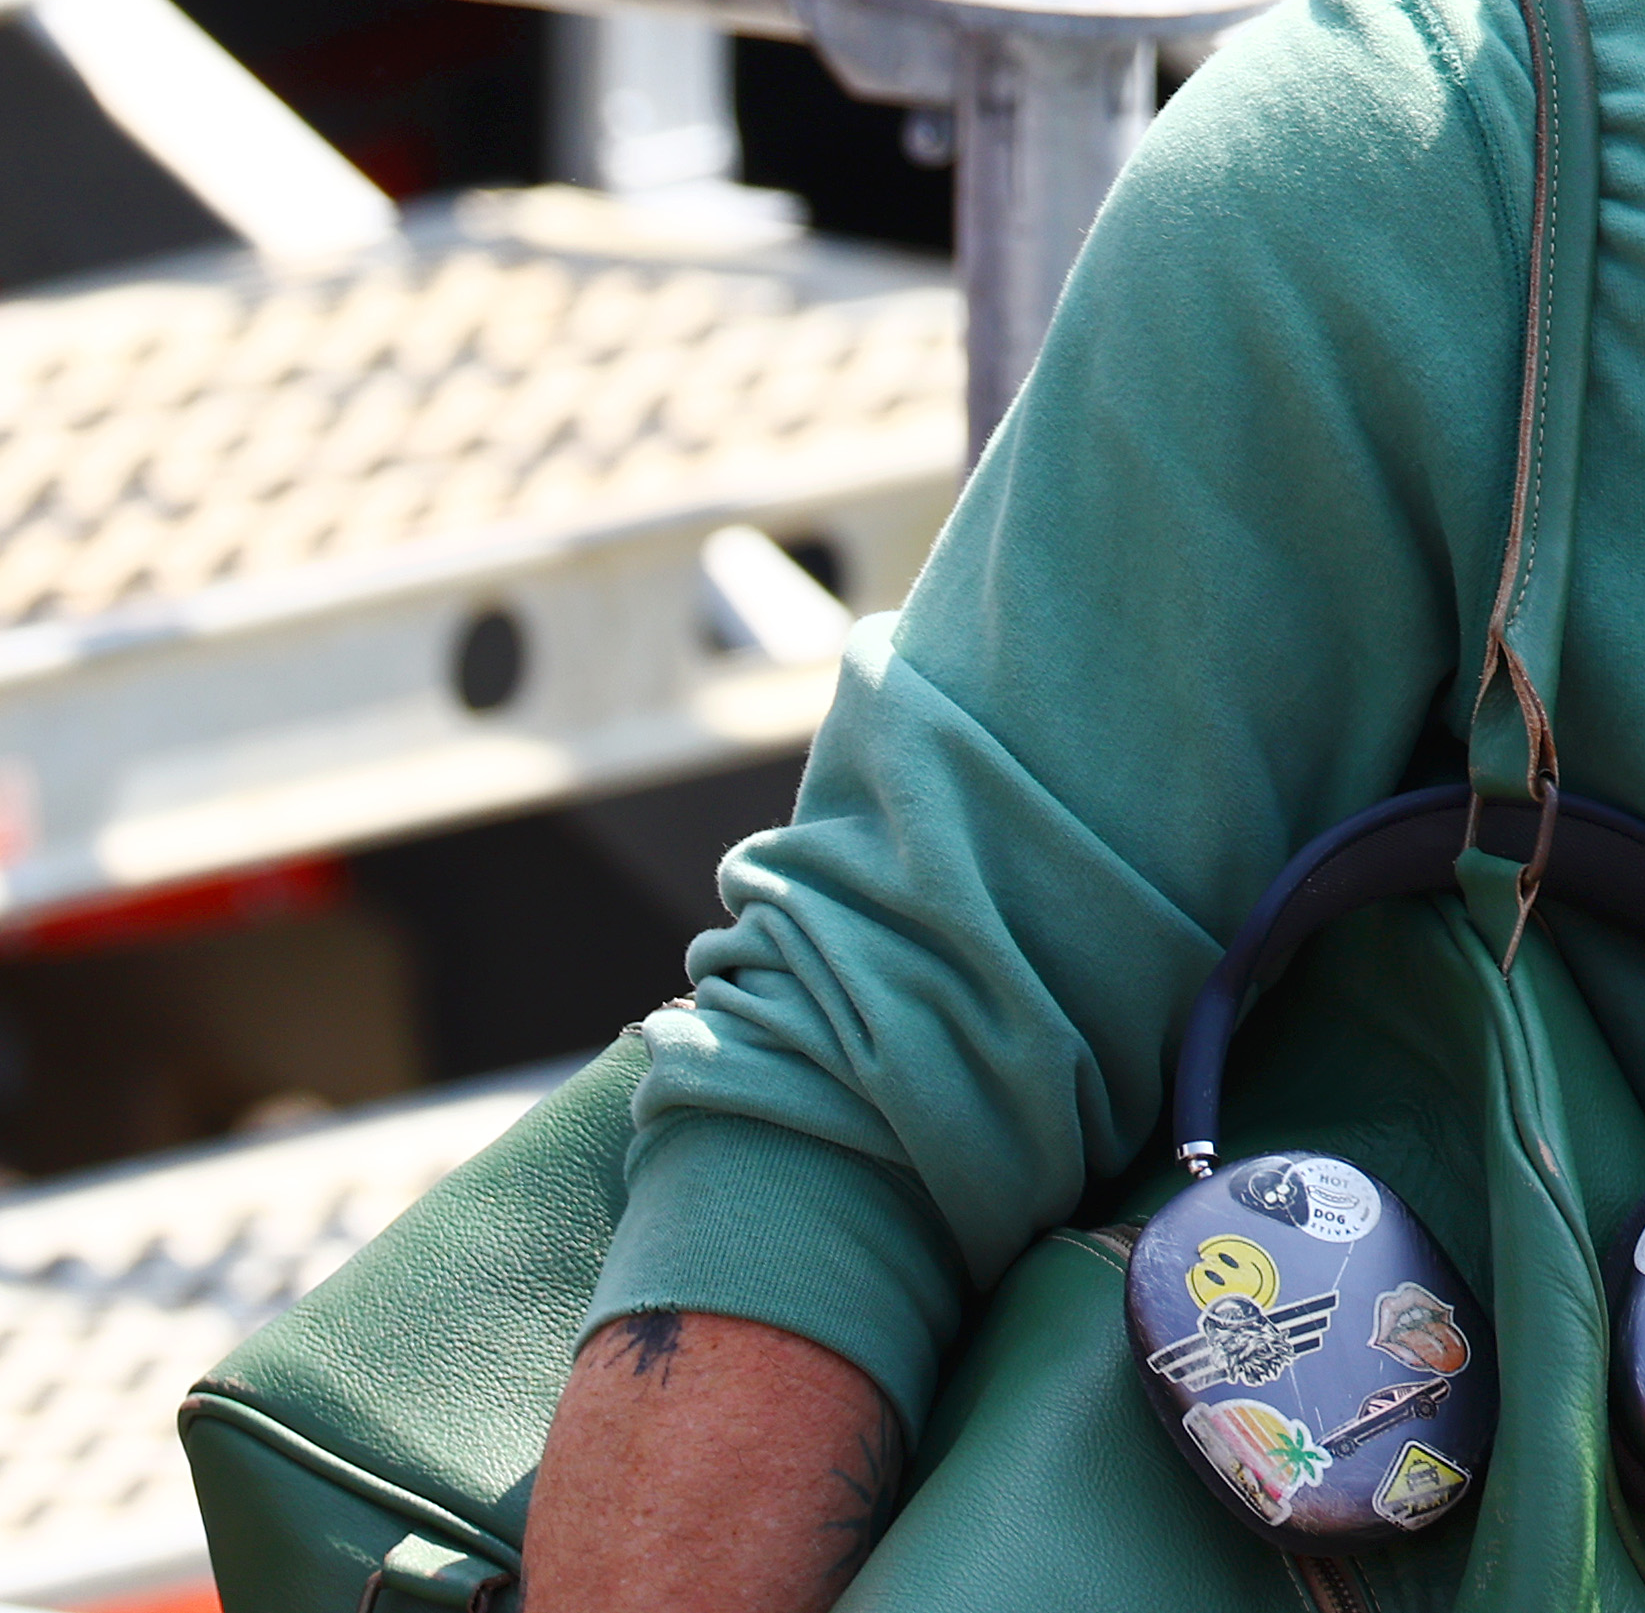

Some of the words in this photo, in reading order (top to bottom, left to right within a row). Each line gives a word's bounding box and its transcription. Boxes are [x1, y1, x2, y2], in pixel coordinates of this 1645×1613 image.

[1320, 1175, 1350, 1189] HOT
[1314, 1208, 1346, 1225] DOG
[1310, 1222, 1361, 1237] STIVAL
